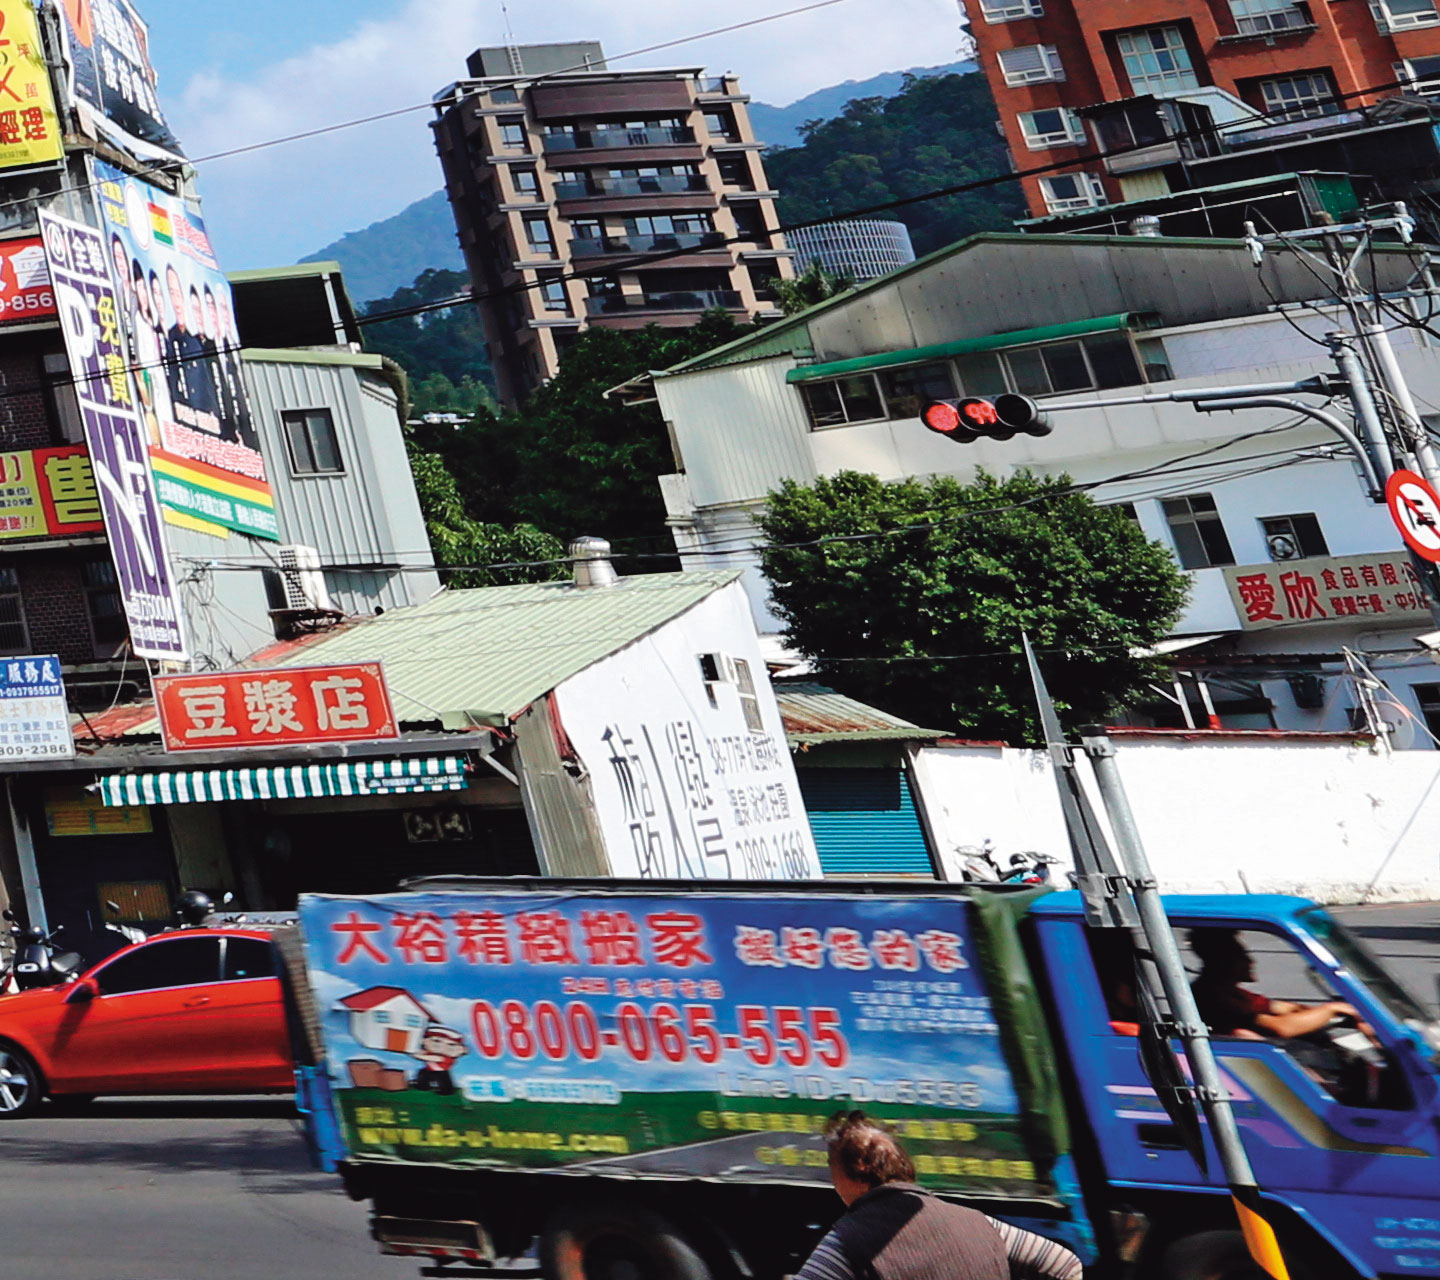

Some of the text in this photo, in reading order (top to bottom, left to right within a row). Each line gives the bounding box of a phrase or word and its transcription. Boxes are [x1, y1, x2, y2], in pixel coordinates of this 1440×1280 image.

[24, 83, 37, 99] 萬
[54, 281, 95, 394] P
[97, 296, 132, 405] 免費
[45, 454, 103, 524] 售
[1237, 570, 1328, 623] 愛欣
[7, 660, 58, 684] 服務處
[178, 675, 370, 738] 豆漿店
[330, 911, 713, 967] 大裕精緻搬家
[468, 999, 850, 1068] 0800-065-555
[716, 1073, 791, 1098] Line
